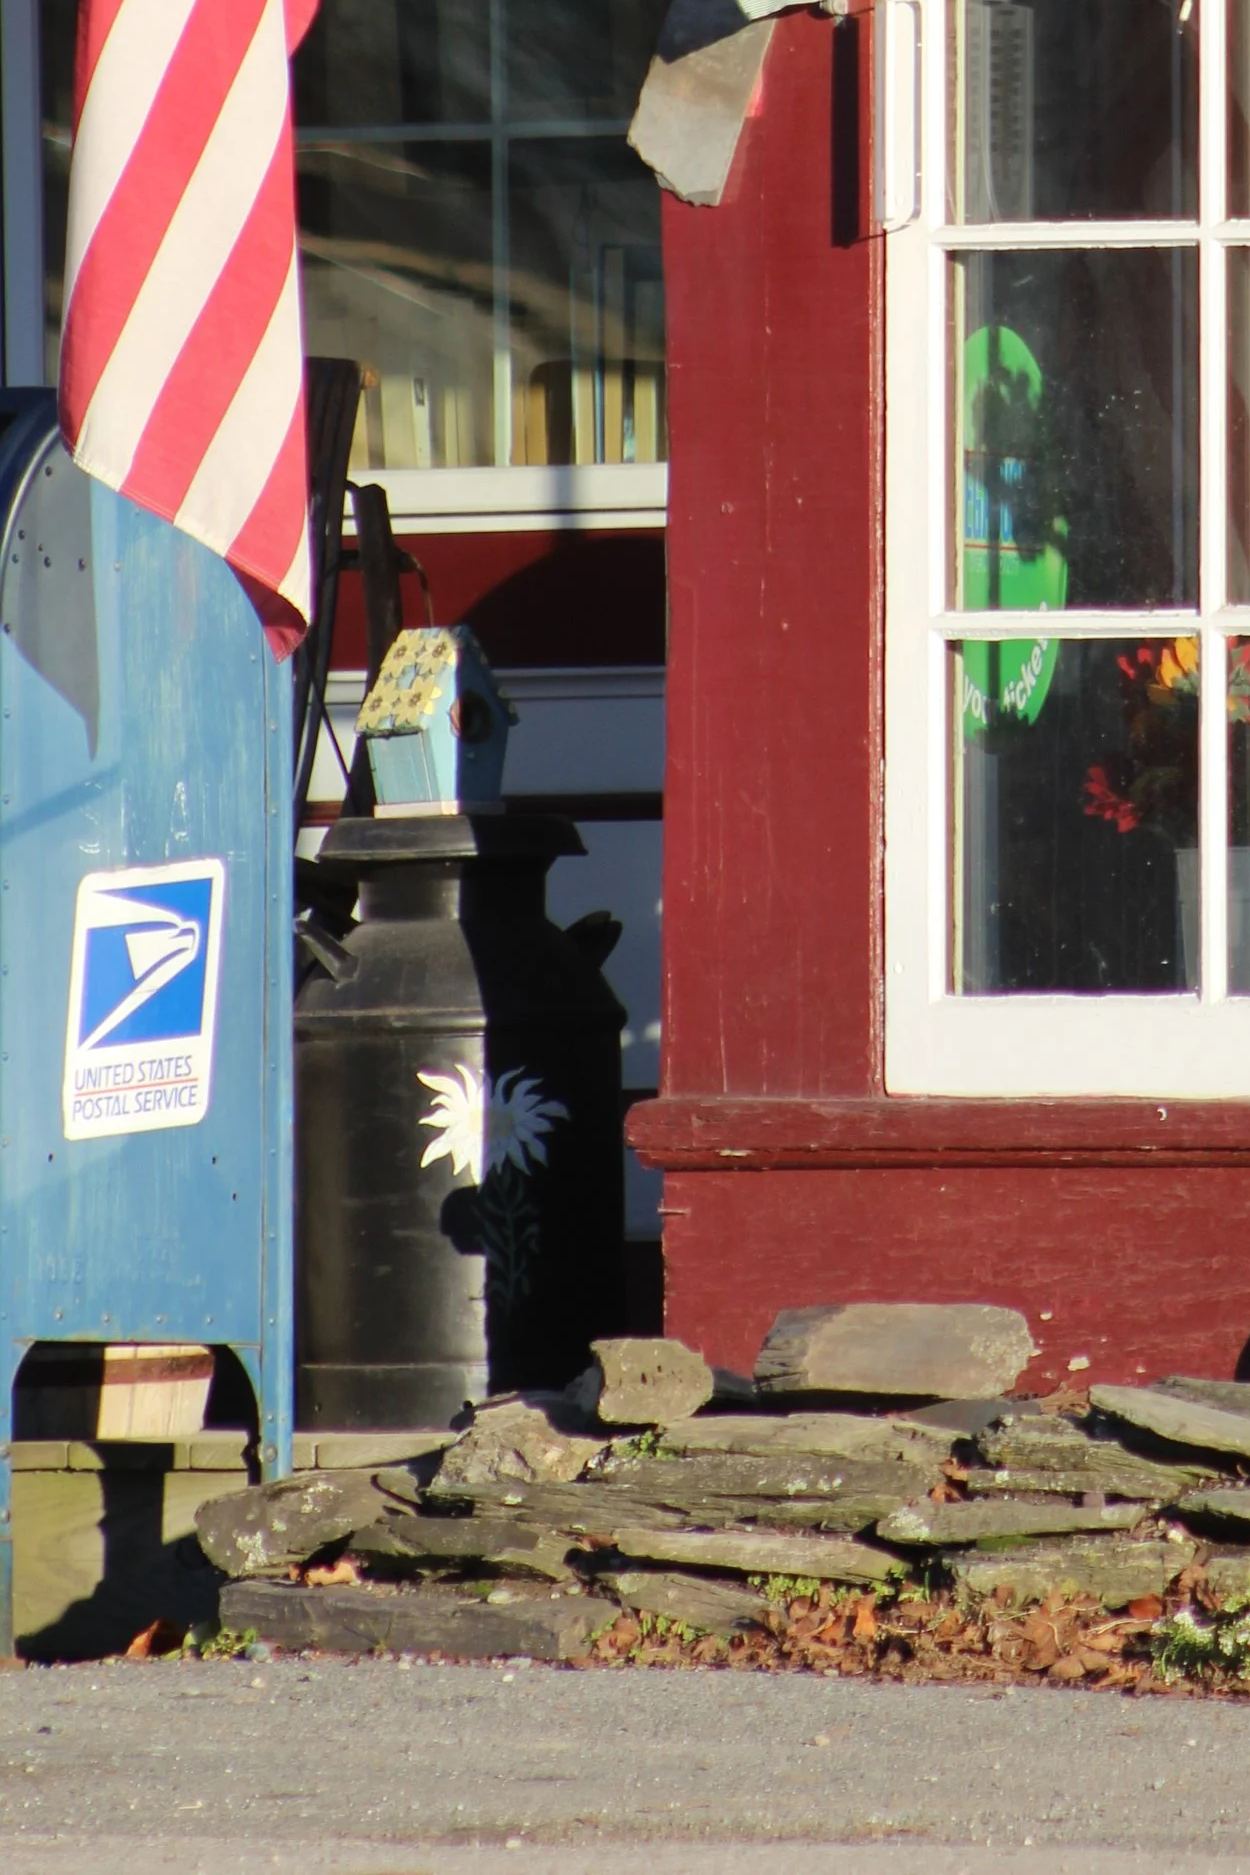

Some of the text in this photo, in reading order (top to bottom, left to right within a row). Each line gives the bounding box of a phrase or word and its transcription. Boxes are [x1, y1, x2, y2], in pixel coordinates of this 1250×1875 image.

[74, 1054, 193, 1091] UNITED STATES
[72, 1084, 198, 1122] POSTAL SERVICE
